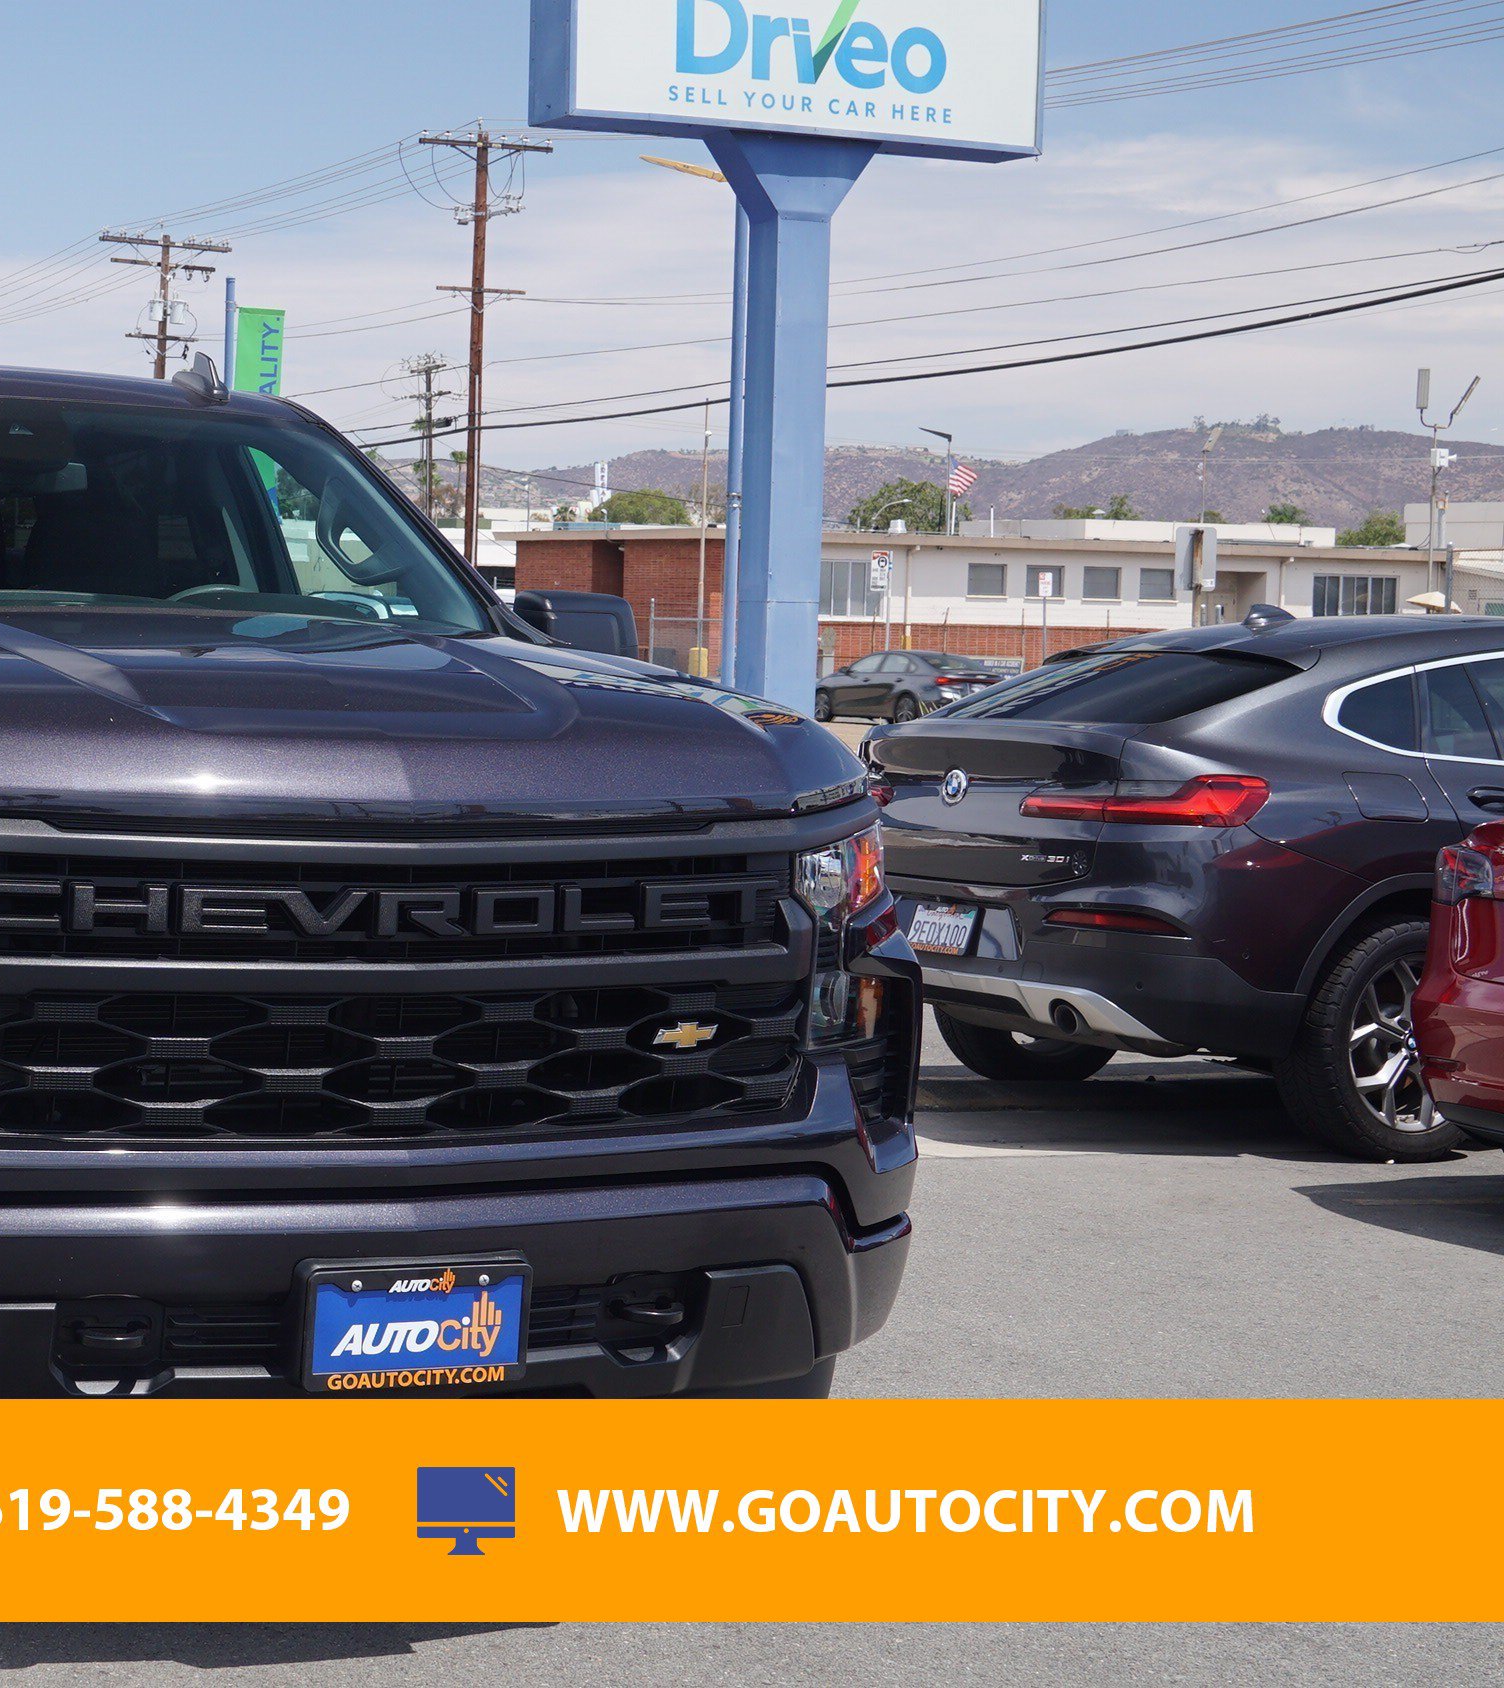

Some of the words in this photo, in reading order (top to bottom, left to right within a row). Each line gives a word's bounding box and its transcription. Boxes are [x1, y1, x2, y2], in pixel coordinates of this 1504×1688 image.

[676, 0, 947, 94] Driveo
[668, 85, 728, 106] SELL
[744, 91, 813, 113] YOUR
[828, 98, 876, 118] CAR
[892, 104, 952, 124] HERE
[259, 317, 280, 394] ALITY.
[327, 1366, 505, 1391] GOAUTOCITY.COM
